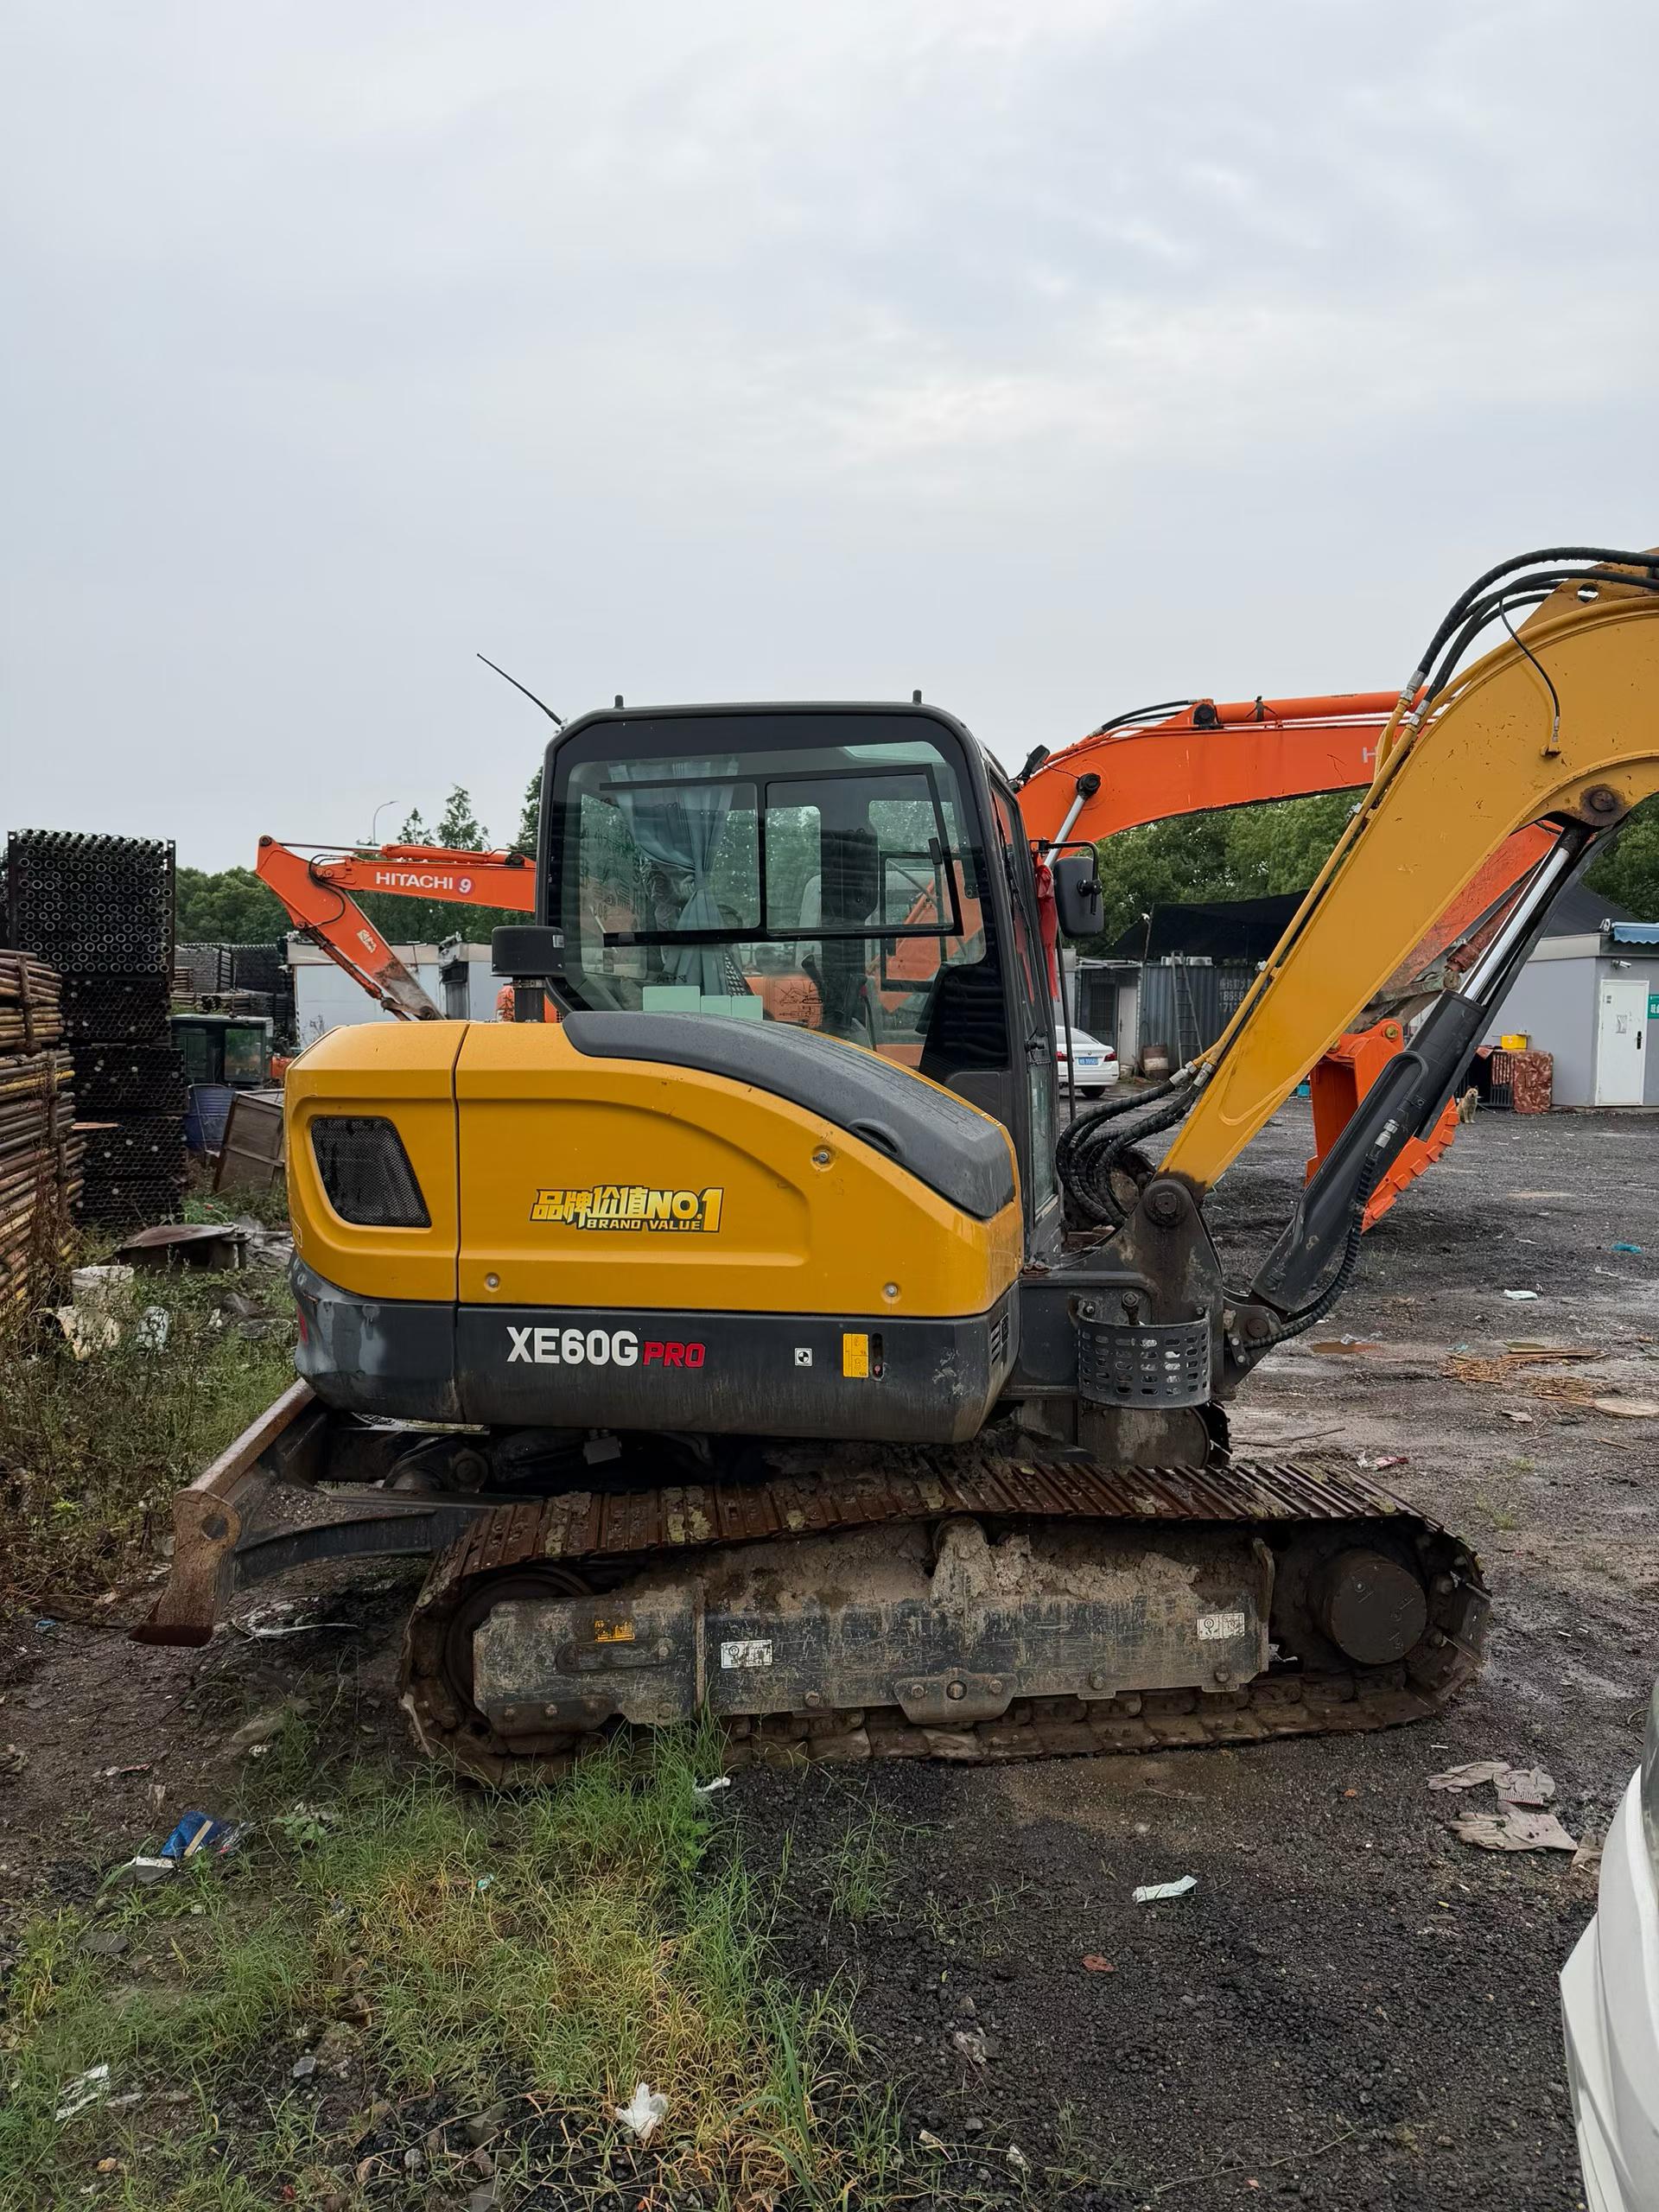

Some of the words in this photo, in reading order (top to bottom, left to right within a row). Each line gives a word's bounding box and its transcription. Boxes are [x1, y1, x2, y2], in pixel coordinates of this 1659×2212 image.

[376, 872, 454, 890] HITACHI
[587, 1219, 641, 1230] BRAND
[650, 1219, 702, 1230] VALUE
[506, 1326, 639, 1367] XE60G
[643, 1341, 706, 1369] PRO
